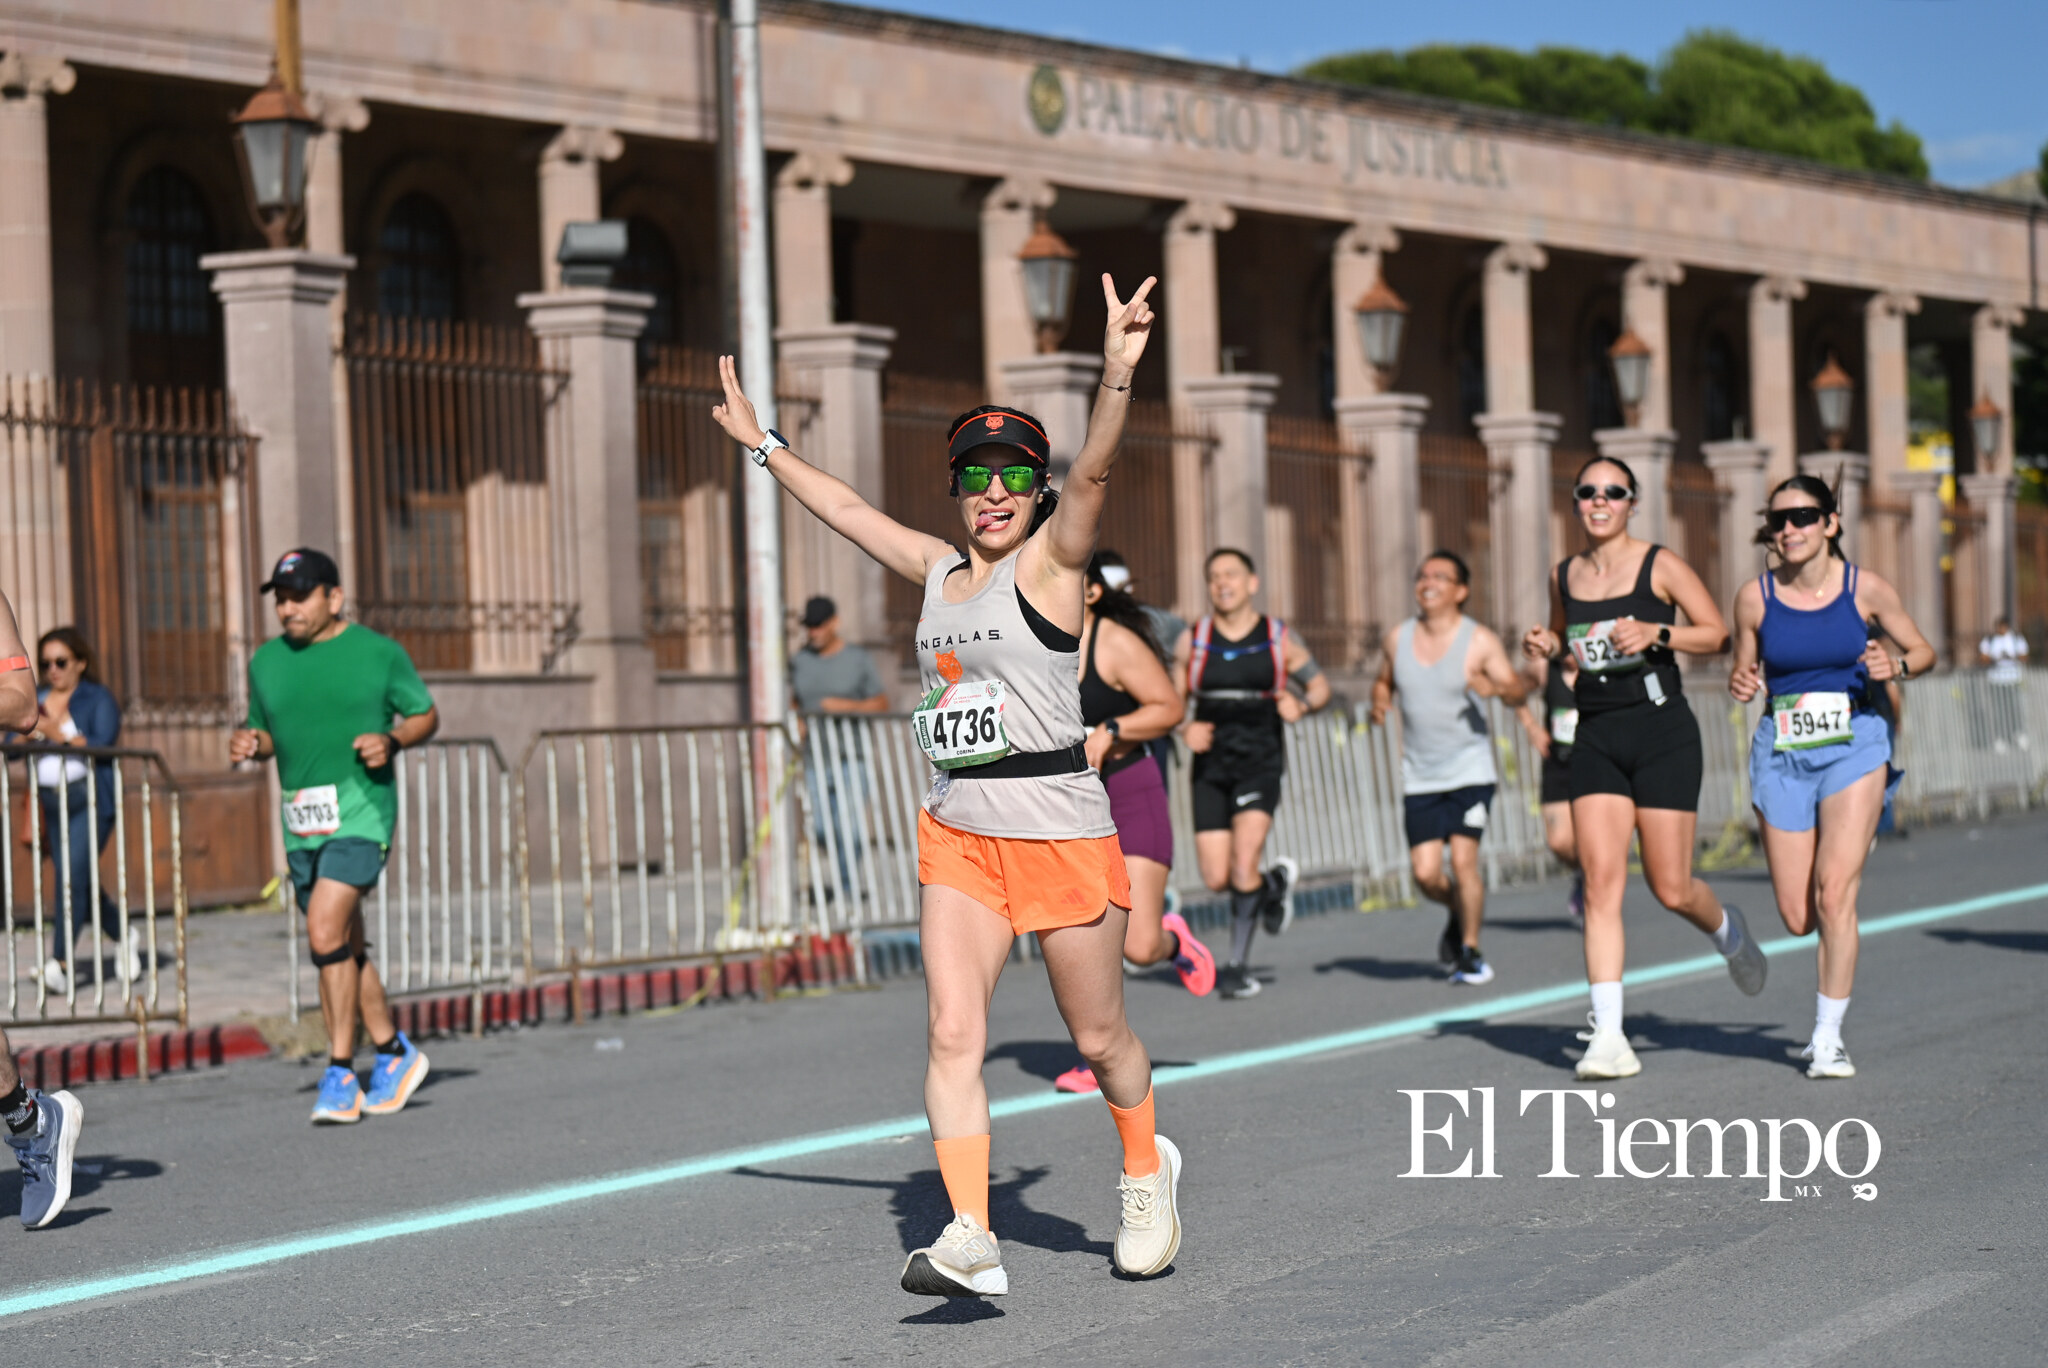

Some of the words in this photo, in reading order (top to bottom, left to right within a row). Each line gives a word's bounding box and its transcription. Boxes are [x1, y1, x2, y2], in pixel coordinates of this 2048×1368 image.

[1076, 73, 1262, 154] PALACIO
[1279, 105, 1333, 164] DE
[1342, 114, 1508, 188] JUSTICIA
[920, 717, 931, 748] COAHUILA
[933, 706, 996, 749] 4736
[1792, 710, 1842, 736] 5947
[956, 748, 976, 756] CORINA
